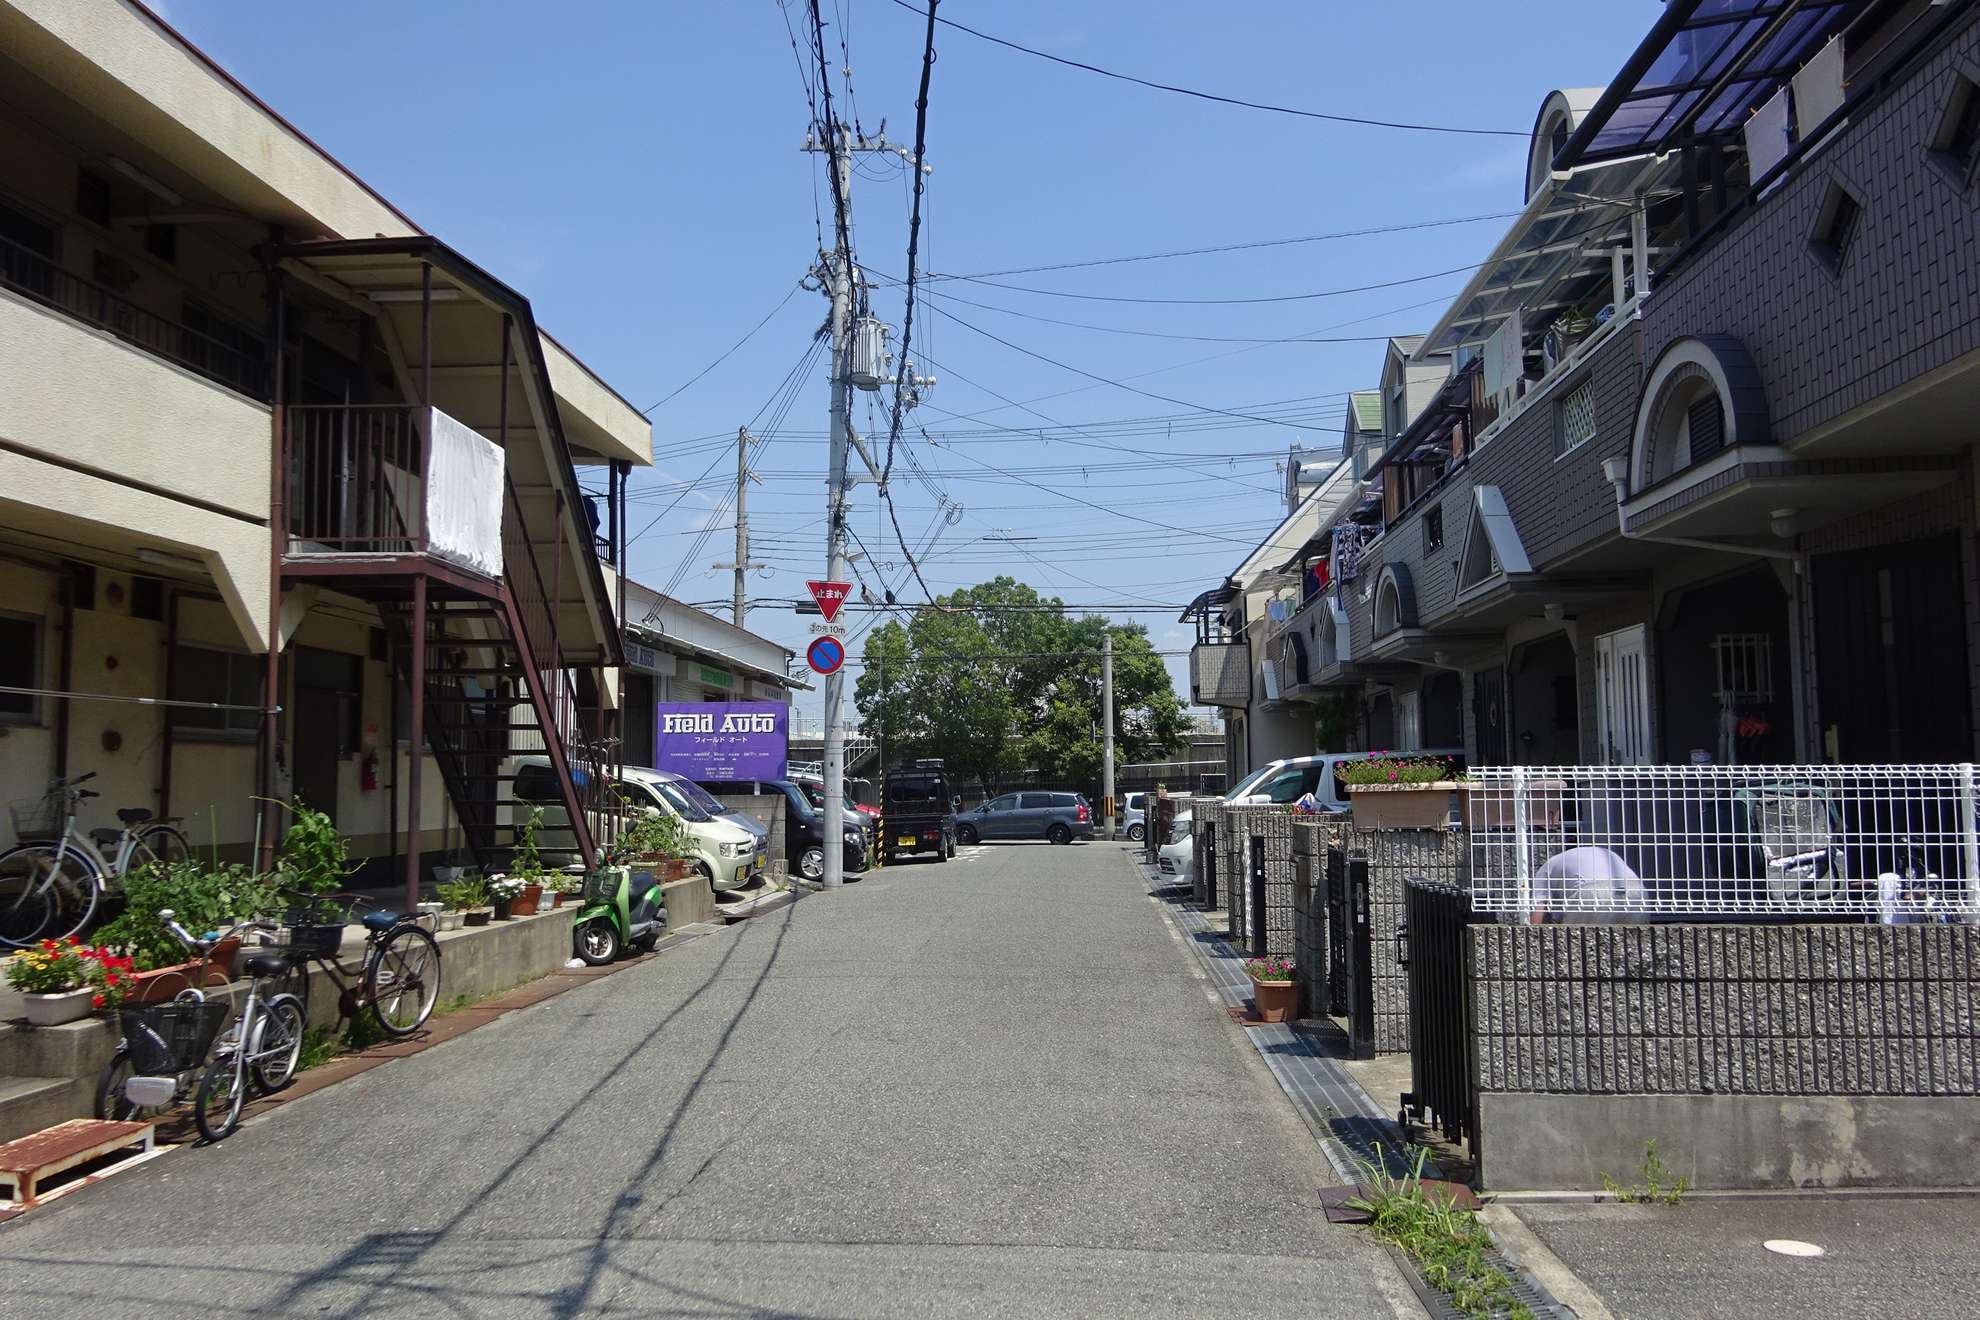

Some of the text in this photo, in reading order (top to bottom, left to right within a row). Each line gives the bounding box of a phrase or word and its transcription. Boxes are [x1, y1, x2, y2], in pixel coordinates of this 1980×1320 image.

[816, 589, 843, 599] 止まれ
[663, 713, 776, 733] Field Auto
[694, 736, 726, 744] フィールド
